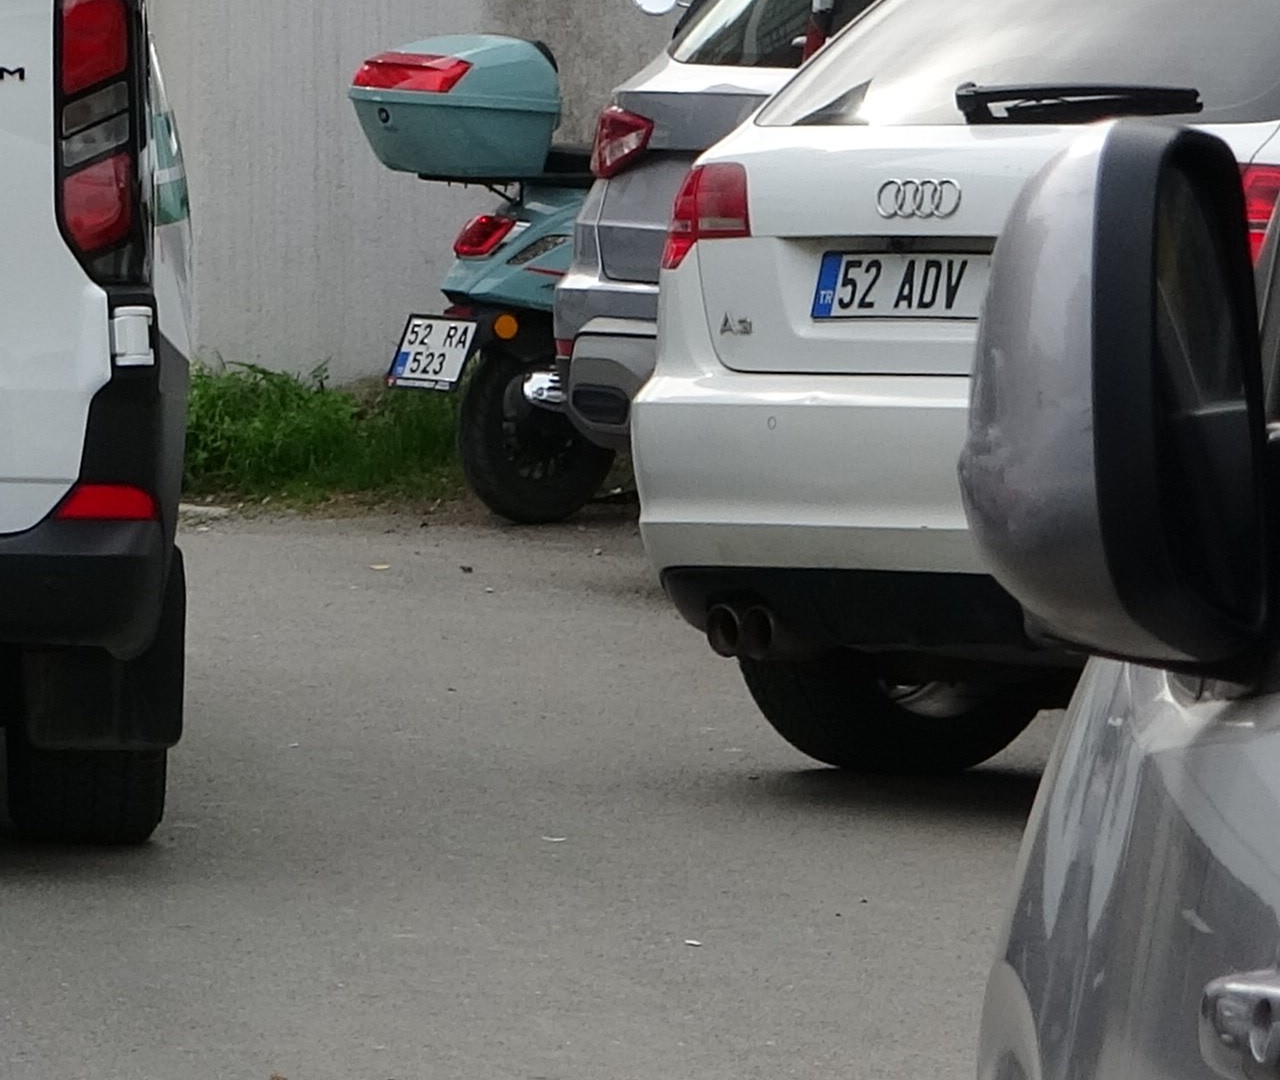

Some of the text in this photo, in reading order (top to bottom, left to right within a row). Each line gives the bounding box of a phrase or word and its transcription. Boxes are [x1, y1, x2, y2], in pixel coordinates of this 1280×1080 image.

[819, 259, 969, 310] TR 52 ADV
[407, 323, 469, 350] 52 RA
[409, 351, 447, 375] 523
